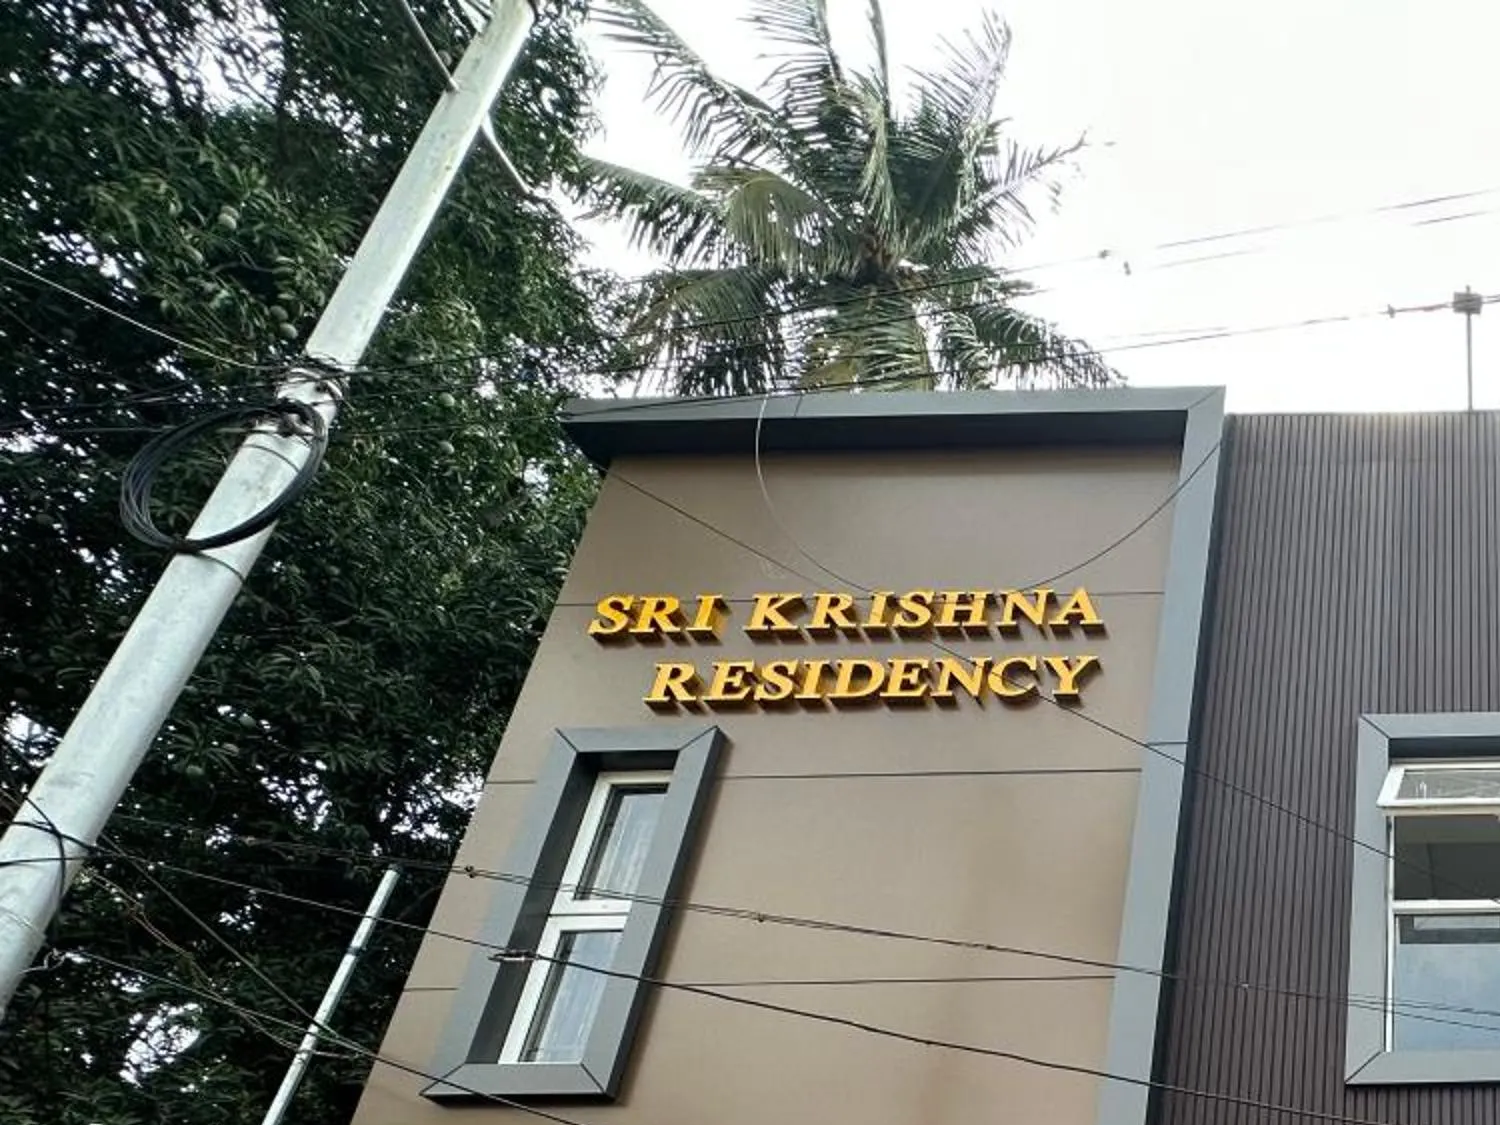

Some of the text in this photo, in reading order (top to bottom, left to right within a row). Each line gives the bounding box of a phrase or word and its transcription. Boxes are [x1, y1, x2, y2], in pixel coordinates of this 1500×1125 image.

[588, 586, 1107, 640] SRI KRISHNA
[643, 654, 1100, 708] RESIDENCY
